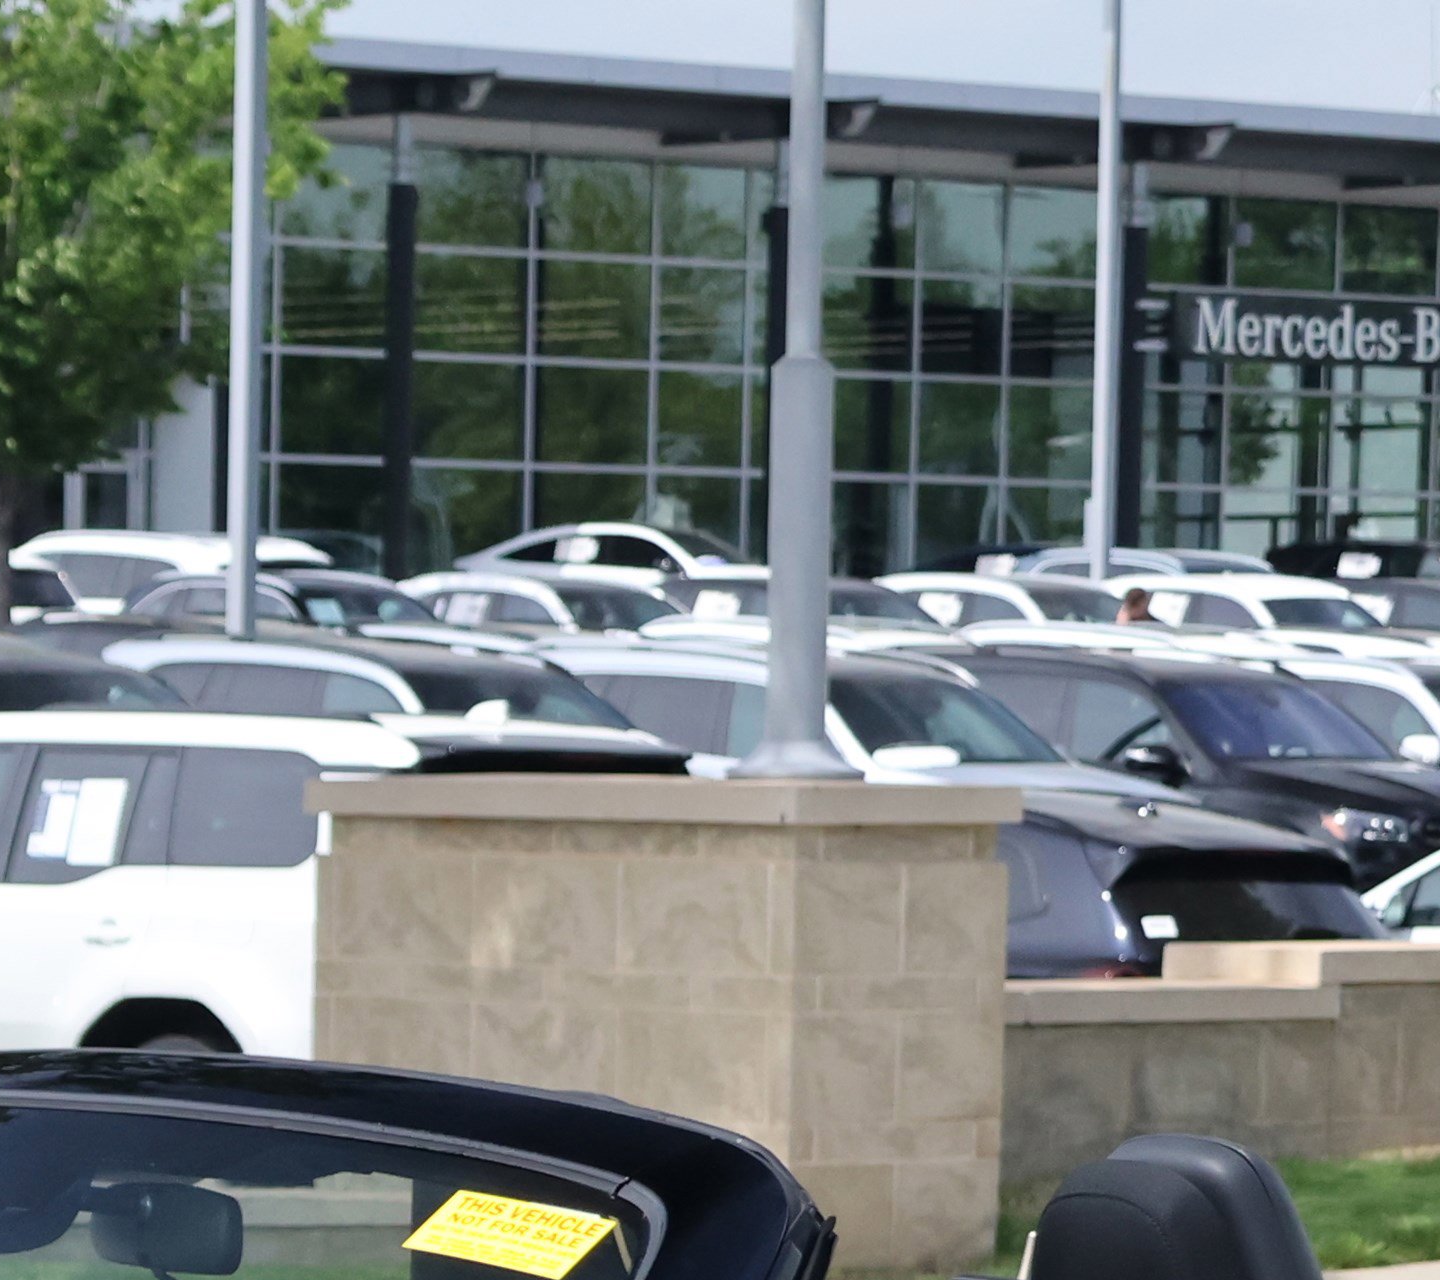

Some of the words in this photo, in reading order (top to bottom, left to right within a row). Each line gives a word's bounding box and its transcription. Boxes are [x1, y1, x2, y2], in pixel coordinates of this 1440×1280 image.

[447, 1212, 486, 1227] NOT
[488, 1220, 530, 1237] FOR
[531, 1229, 584, 1250] SALE
[457, 1196, 509, 1217] THIS
[510, 1205, 604, 1239] VEHICLE
